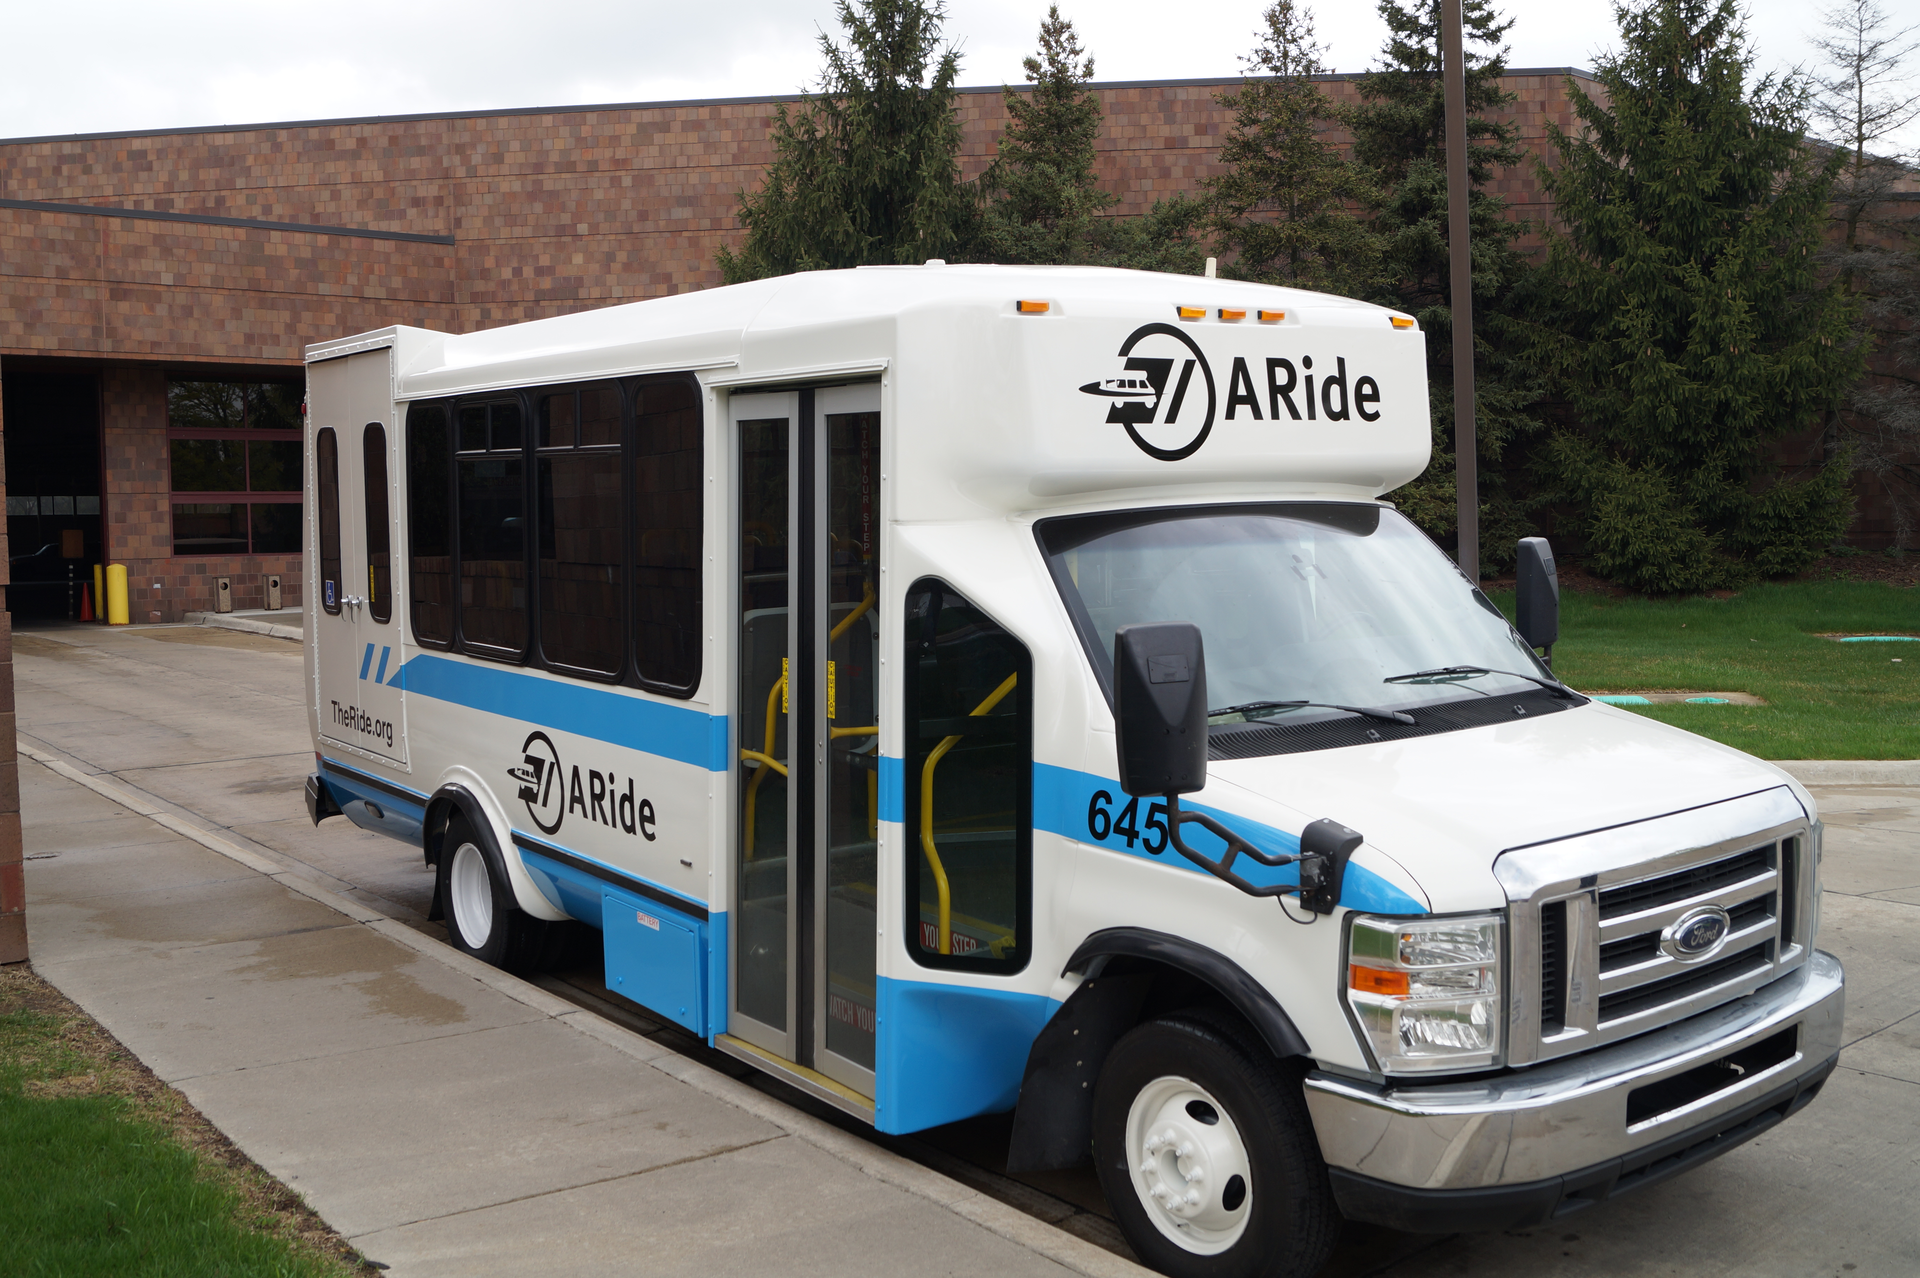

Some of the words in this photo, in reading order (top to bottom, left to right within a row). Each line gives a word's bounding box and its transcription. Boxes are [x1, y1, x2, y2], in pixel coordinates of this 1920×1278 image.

[1224, 354, 1381, 422] ARide
[331, 700, 392, 748] TheRide.org
[569, 764, 656, 842] ARide
[1088, 789, 1168, 855] 645
[637, 912, 659, 929] BATTERY
[1691, 923, 1719, 946] Ford
[856, 1005, 876, 1033] YOU
